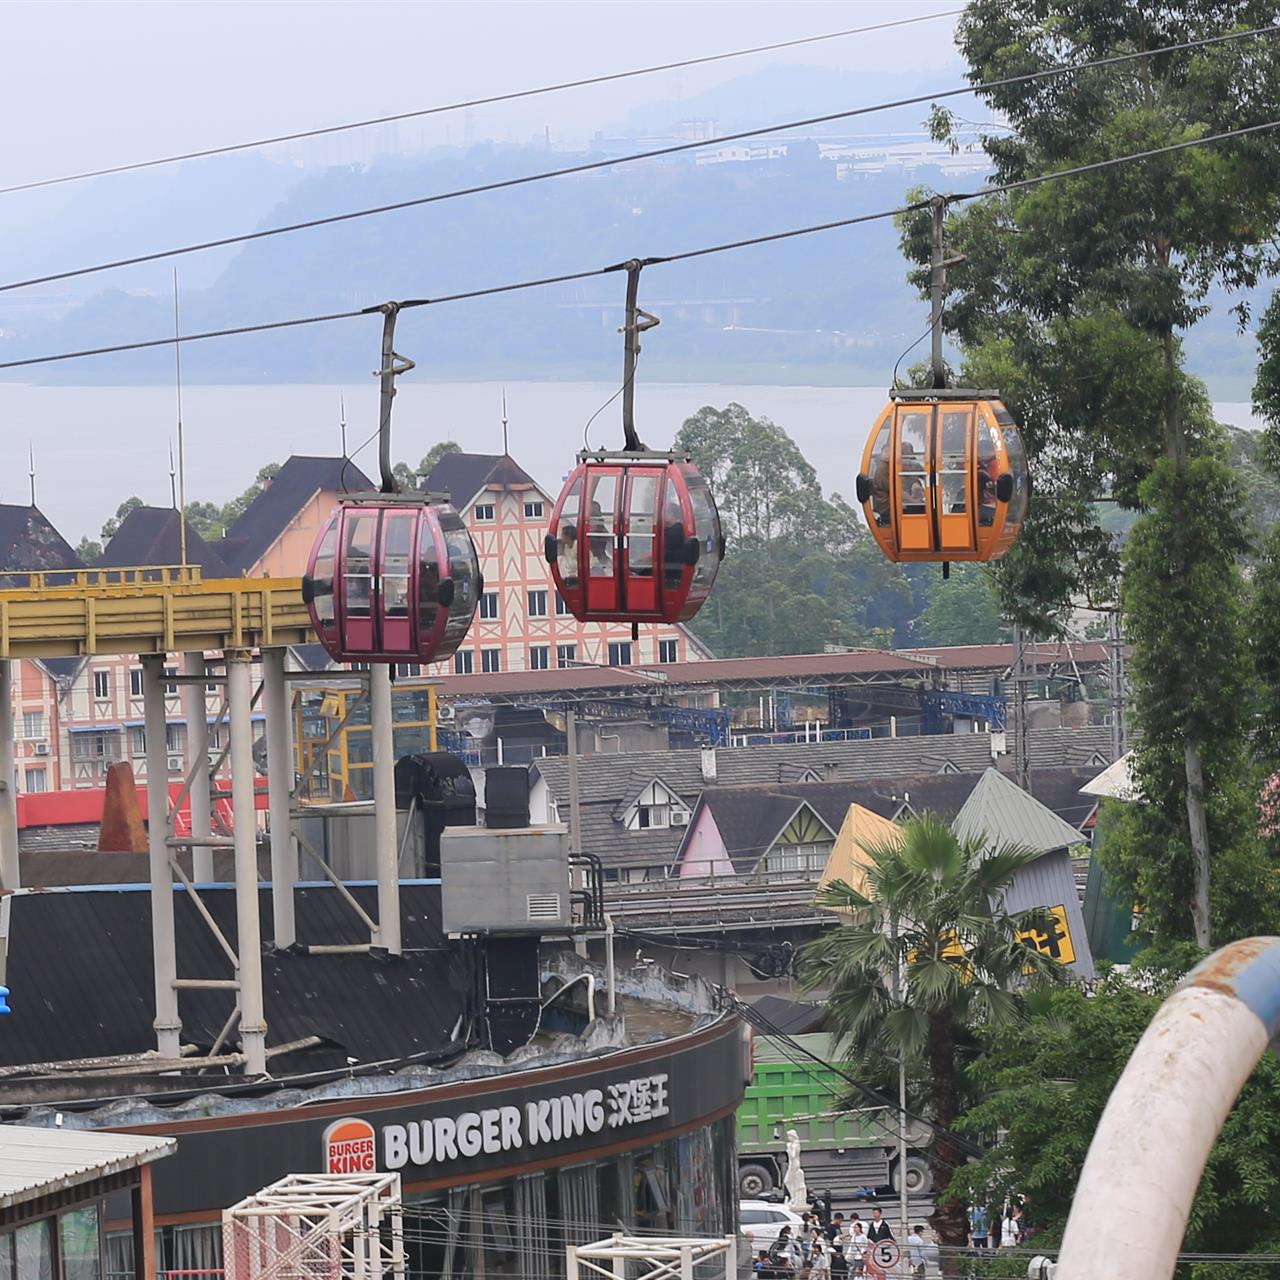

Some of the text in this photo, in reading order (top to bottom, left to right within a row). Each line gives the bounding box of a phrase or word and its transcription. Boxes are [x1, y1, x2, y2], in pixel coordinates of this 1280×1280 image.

[382, 1073, 670, 1170] BURGER KING 汉堡王
[329, 1140, 374, 1158] BURGER
[329, 1153, 375, 1174] KING
[880, 1246, 893, 1263] 5
